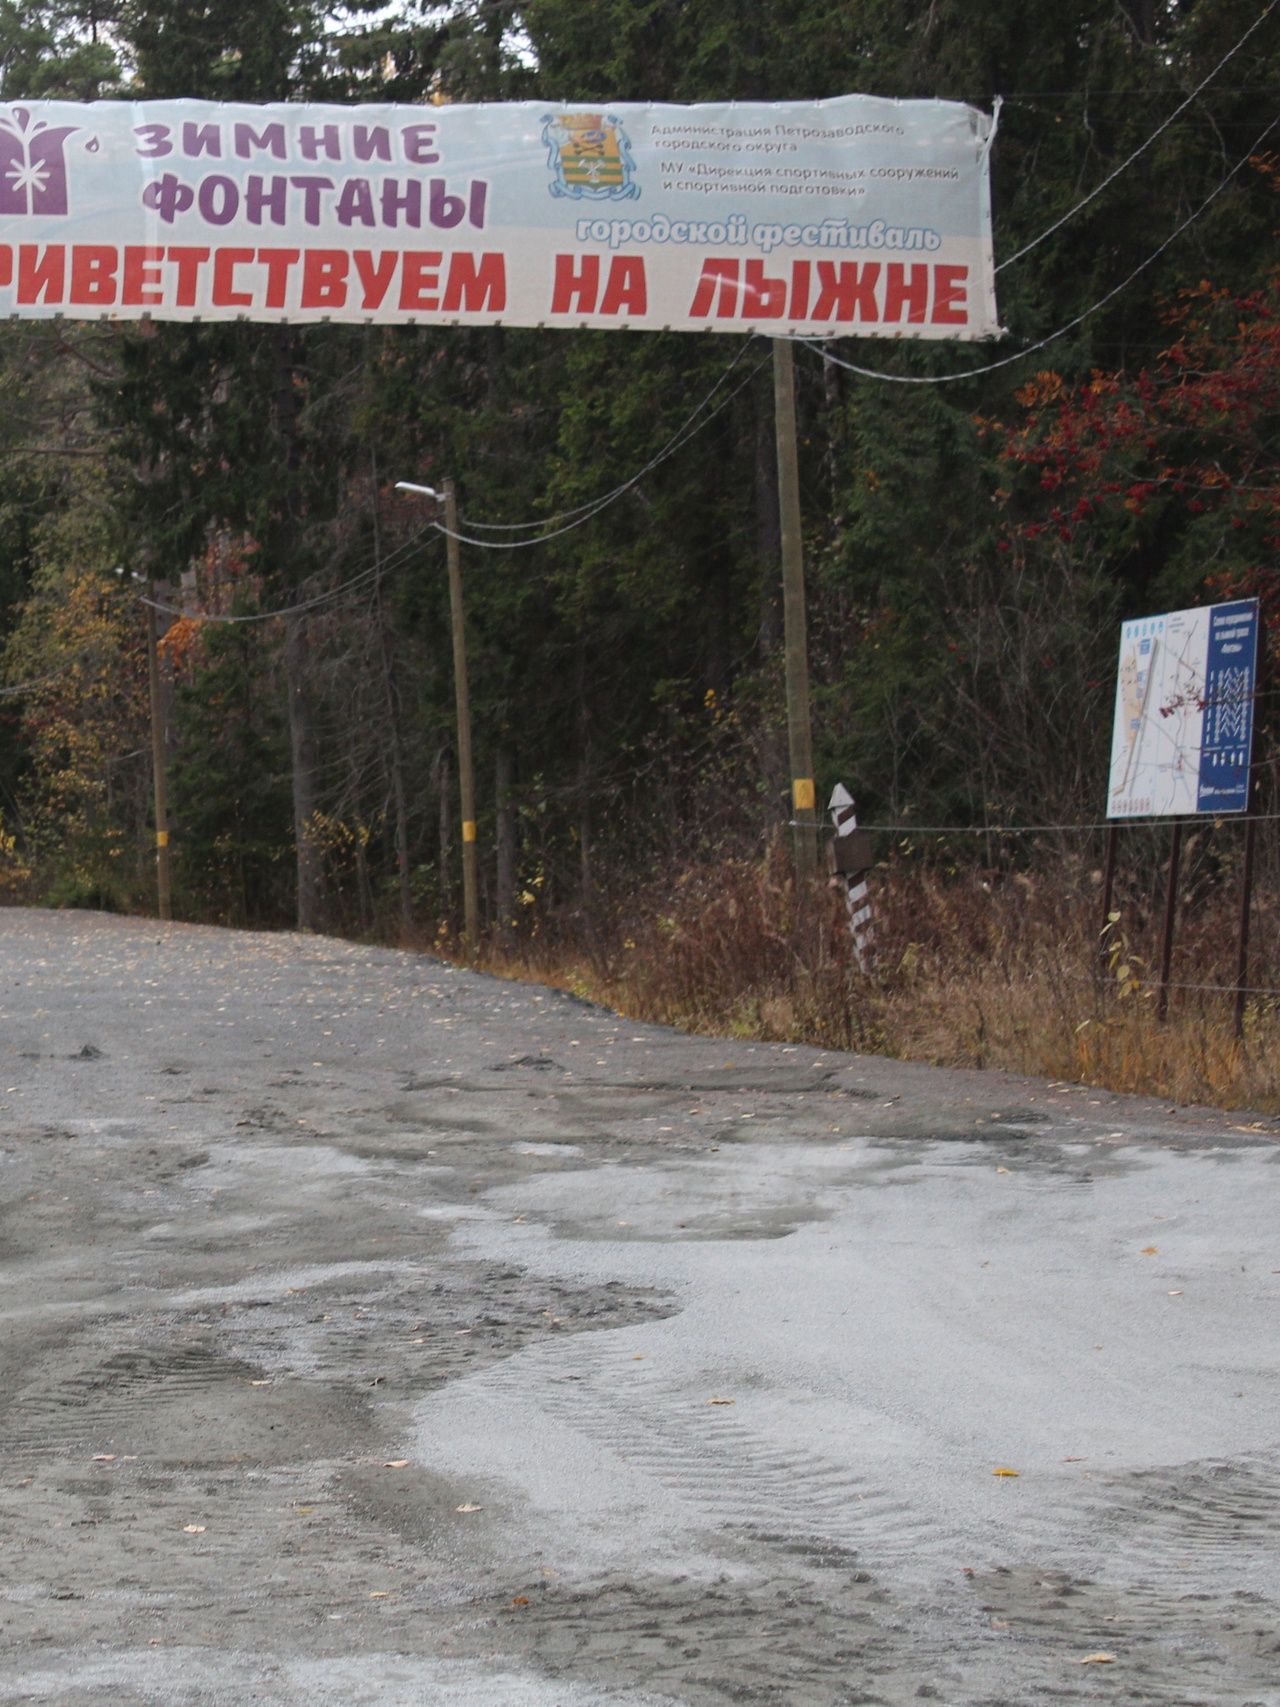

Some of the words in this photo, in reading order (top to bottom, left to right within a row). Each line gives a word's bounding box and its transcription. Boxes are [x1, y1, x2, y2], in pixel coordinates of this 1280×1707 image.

[133, 122, 440, 164] ЗИМНИЕ
[651, 124, 770, 138] Администрация
[774, 123, 905, 139] Петрозаводского
[655, 139, 741, 151] городского
[745, 143, 797, 153] округа
[661, 161, 684, 174] МУ
[688, 163, 770, 177] «Дирекция
[775, 167, 864, 181] спортивных
[869, 167, 959, 181] сооружений
[142, 173, 487, 229] ФОНТАНЫ
[663, 181, 672, 190] и
[676, 180, 765, 194] спортивной
[770, 183, 865, 196] подготовки»
[576, 213, 748, 249] городской
[752, 218, 942, 253] фестиваль
[551, 254, 647, 316] НА
[689, 257, 969, 324] ЛЫЖНЕ
